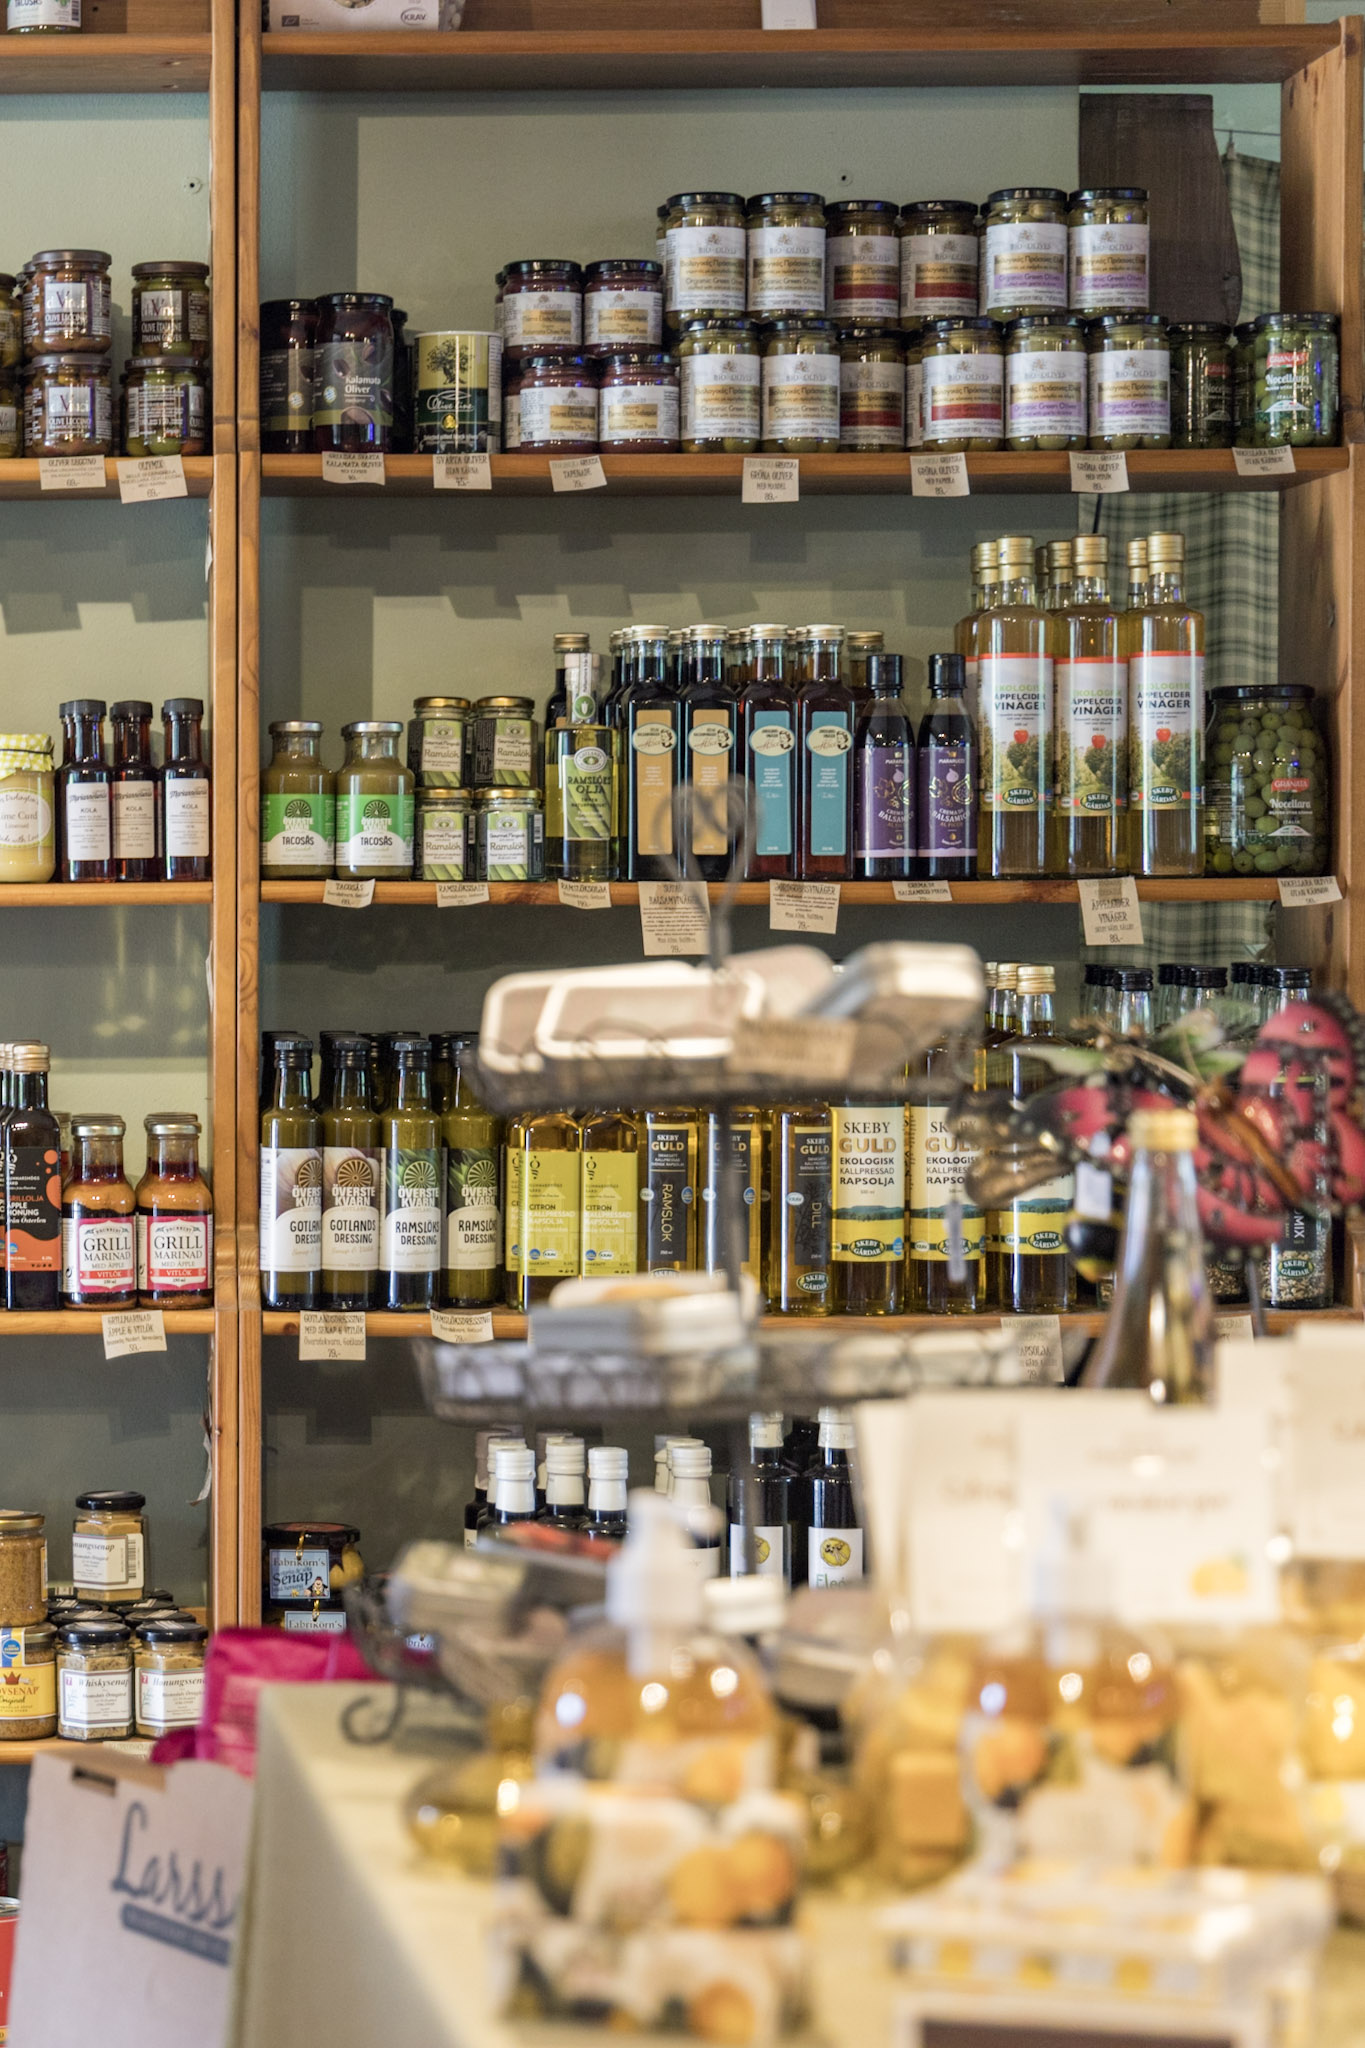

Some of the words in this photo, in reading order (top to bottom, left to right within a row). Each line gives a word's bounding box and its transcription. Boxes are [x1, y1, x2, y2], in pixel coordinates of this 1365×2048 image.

[346, 376, 381, 385] Kalamata
[345, 385, 371, 394] Oliver
[1131, 401, 1149, 409] Green
[436, 456, 461, 465] SVARTA
[462, 456, 487, 464] OLIVER
[939, 465, 960, 475] OLIVER
[1099, 463, 1120, 472] OLIVER
[772, 472, 793, 481] OLIVER
[1072, 705, 1122, 715] VINÄGER
[424, 749, 459, 759] Ramslök
[497, 748, 531, 758] Ramslök
[1010, 788, 1032, 796] SKEBY
[1088, 793, 1109, 801] SKEBY
[1007, 796, 1034, 804] GÅRDAR
[1149, 794, 1177, 803] GÅRDAR
[1270, 798, 1311, 808] Nocellara
[1086, 801, 1111, 810] GÅRDAR
[18, 811, 37, 820] Curd
[282, 835, 314, 845] TACOSÅS
[361, 836, 392, 846] TACOSÅS
[426, 841, 461, 851] Ramslök
[490, 841, 525, 851] Ramslök
[844, 1122, 890, 1133] SKEBY
[930, 1121, 976, 1133] SKBY
[652, 1142, 684, 1151] GULD
[713, 1142, 747, 1151] GLD
[800, 1145, 829, 1154] GULD
[839, 1137, 896, 1153] GULD
[840, 1157, 894, 1165] EKOLOGISK
[926, 1156, 976, 1165] EKOLOGIS
[840, 1167, 894, 1175] KALLPRESSAD
[840, 1177, 895, 1186] RAPSOLJA
[926, 1176, 966, 1184] RAPSO
[292, 1184, 321, 1198] ÖVERS
[332, 1184, 376, 1197] ÖVERSTE
[398, 1185, 439, 1198] ÖVERSTE
[335, 1197, 371, 1206] KVARN
[401, 1198, 435, 1207] KVARN
[661, 1183, 673, 1242] RAMSLÖK
[810, 1202, 822, 1229] DILL
[290, 1220, 321, 1233] GOTLAN
[330, 1220, 376, 1232] GOTLANDS
[396, 1220, 440, 1233] RAMSLÖKS
[459, 1220, 497, 1232] RAMSLÖK
[295, 1234, 321, 1244] DRESSIN
[334, 1234, 373, 1244] DRESSING
[401, 1234, 437, 1245] DRESSING
[464, 1234, 496, 1244] DRESSING
[1033, 1231, 1057, 1240] SKEBY
[83, 1238, 131, 1252] GRILL
[154, 1235, 203, 1249] GRILL
[855, 1239, 878, 1248] SKEBY
[1032, 1240, 1061, 1249] GÅRDAR
[84, 1252, 131, 1262] MARINAD
[154, 1250, 203, 1260] MARINAD
[853, 1248, 881, 1257] GÅRDAR
[1284, 1260, 1307, 1269] SKEBY
[97, 1270, 122, 1278] VITLÖK
[166, 1268, 192, 1277] VITLÖK
[1281, 1268, 1310, 1276] GÅRDAR
[305, 1326, 317, 1334] MED
[73, 1542, 115, 1552] nungssenap
[272, 1571, 312, 1586] Senap
[79, 1677, 129, 1690] Whiskysenap
[153, 1677, 205, 1688] Honungssen
[0, 1687, 39, 1695] OVSENAP
